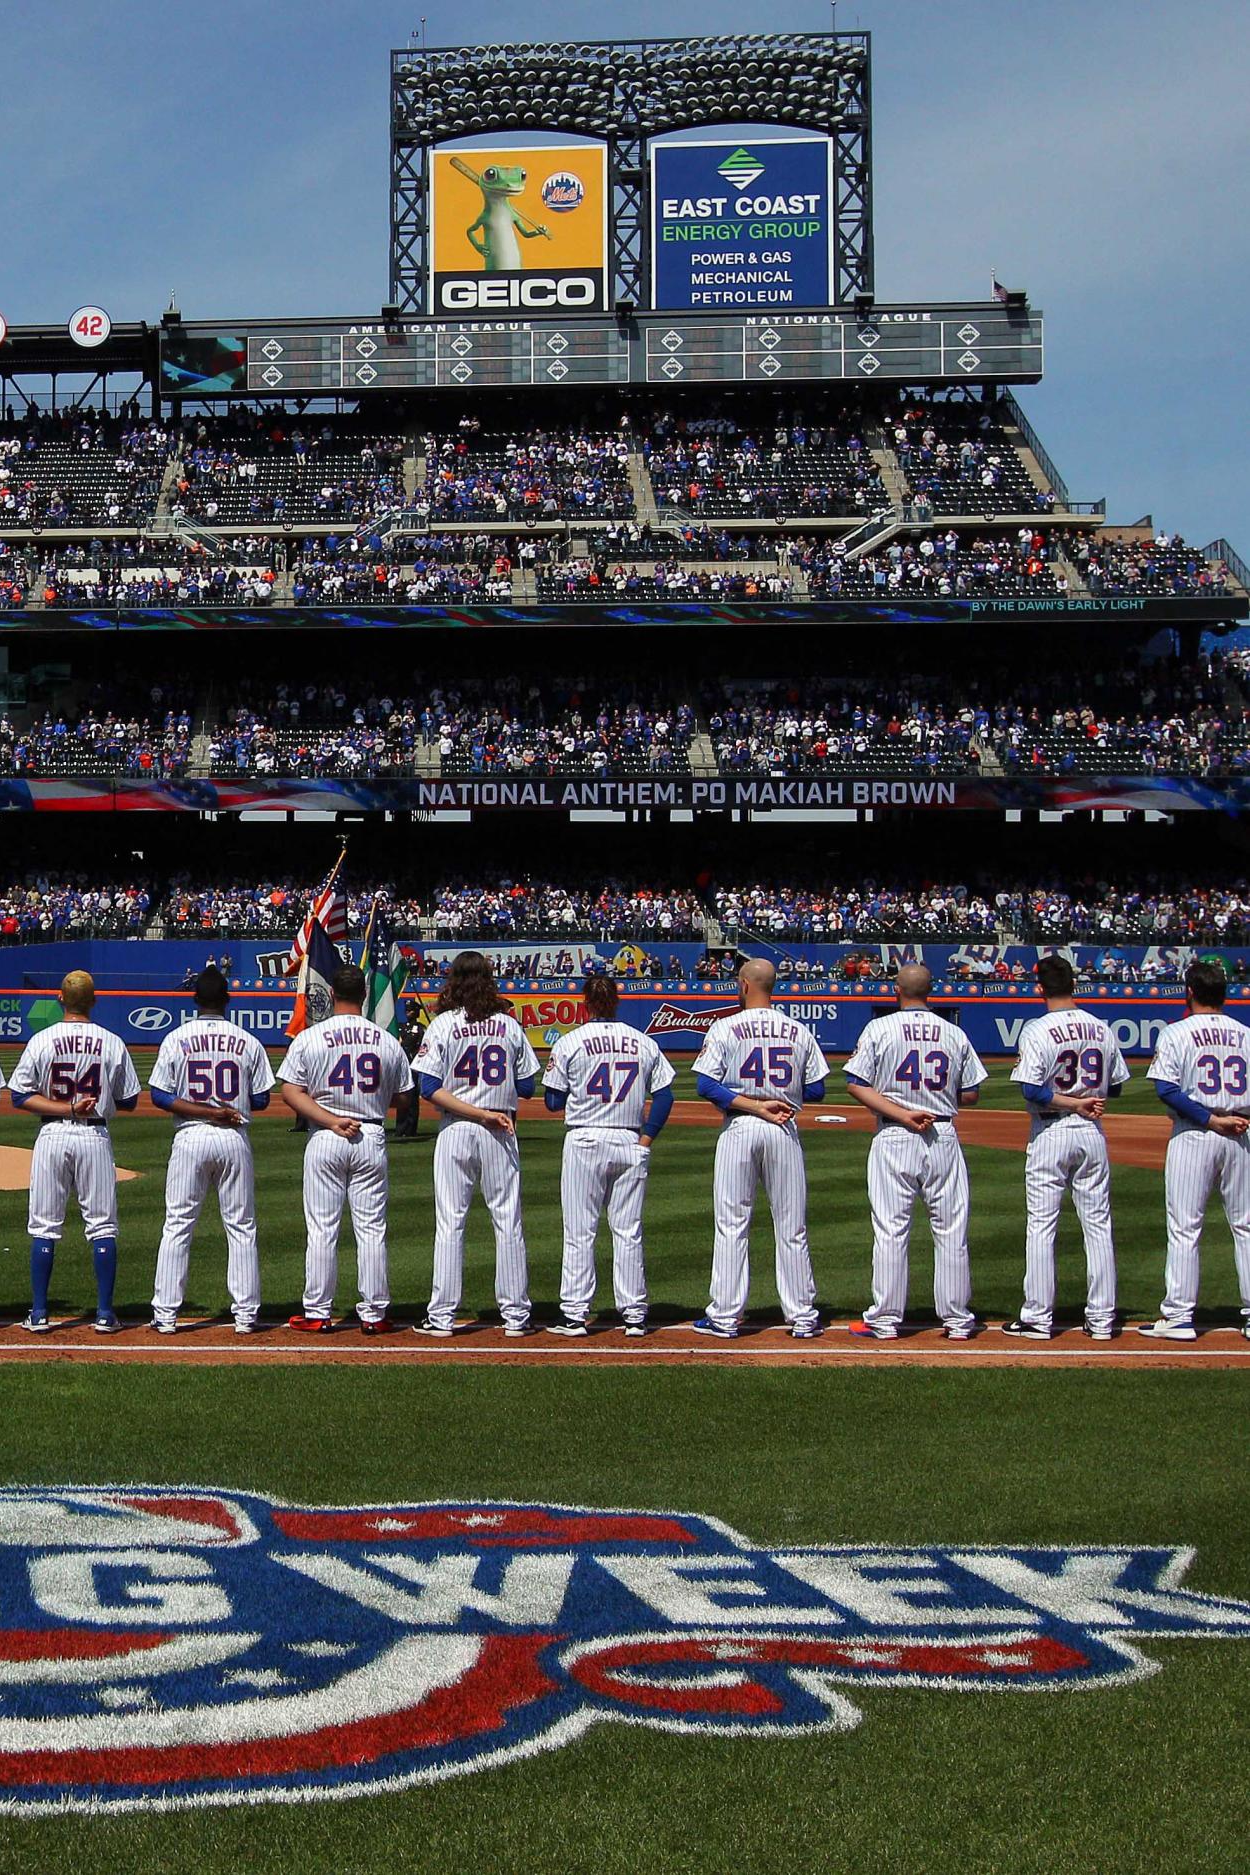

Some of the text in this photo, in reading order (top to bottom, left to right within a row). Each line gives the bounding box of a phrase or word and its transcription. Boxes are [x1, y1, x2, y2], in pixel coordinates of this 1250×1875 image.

[662, 195, 820, 218] EAST COAST
[662, 221, 820, 241] ENERGY GROUP
[691, 251, 792, 265] POWER & GAS
[691, 271, 793, 284] MECHANICAL
[441, 277, 595, 309] GEICO
[691, 290, 793, 303] PETROLEUM
[76, 316, 102, 336] 42
[349, 323, 531, 334] AMERICAN LEAGUE
[746, 313, 931, 325] NATIONAL LEAGUE
[972, 600, 1146, 612] BY THE DAWN'S EARLY LIGHT
[419, 782, 955, 805] NATIONAL ANTHEM: PO MAKIAH BROWN
[790, 1004, 838, 1020] BUD'S
[322, 1027, 381, 1048] SMOKER
[452, 1020, 507, 1040] deGROM
[544, 1028, 560, 1044] hp
[730, 1022, 798, 1044] WHEELER
[902, 1024, 940, 1043] REED
[1048, 1022, 1104, 1044] BLEVINS
[1190, 1028, 1246, 1048] HARVEY
[52, 1036, 104, 1057] RIVERA
[178, 1034, 246, 1056] MONTERO
[582, 1036, 640, 1058] ROBLES
[328, 1052, 381, 1094] 49
[454, 1044, 507, 1086] 48
[740, 1046, 793, 1088] 45
[895, 1048, 949, 1092] 43
[1054, 1048, 1104, 1090] 39
[1197, 1054, 1247, 1096] 33
[51, 1060, 102, 1101] 54
[187, 1060, 240, 1102] 50
[586, 1061, 640, 1104] 47
[268, 1547, 1250, 1630] WEEK
